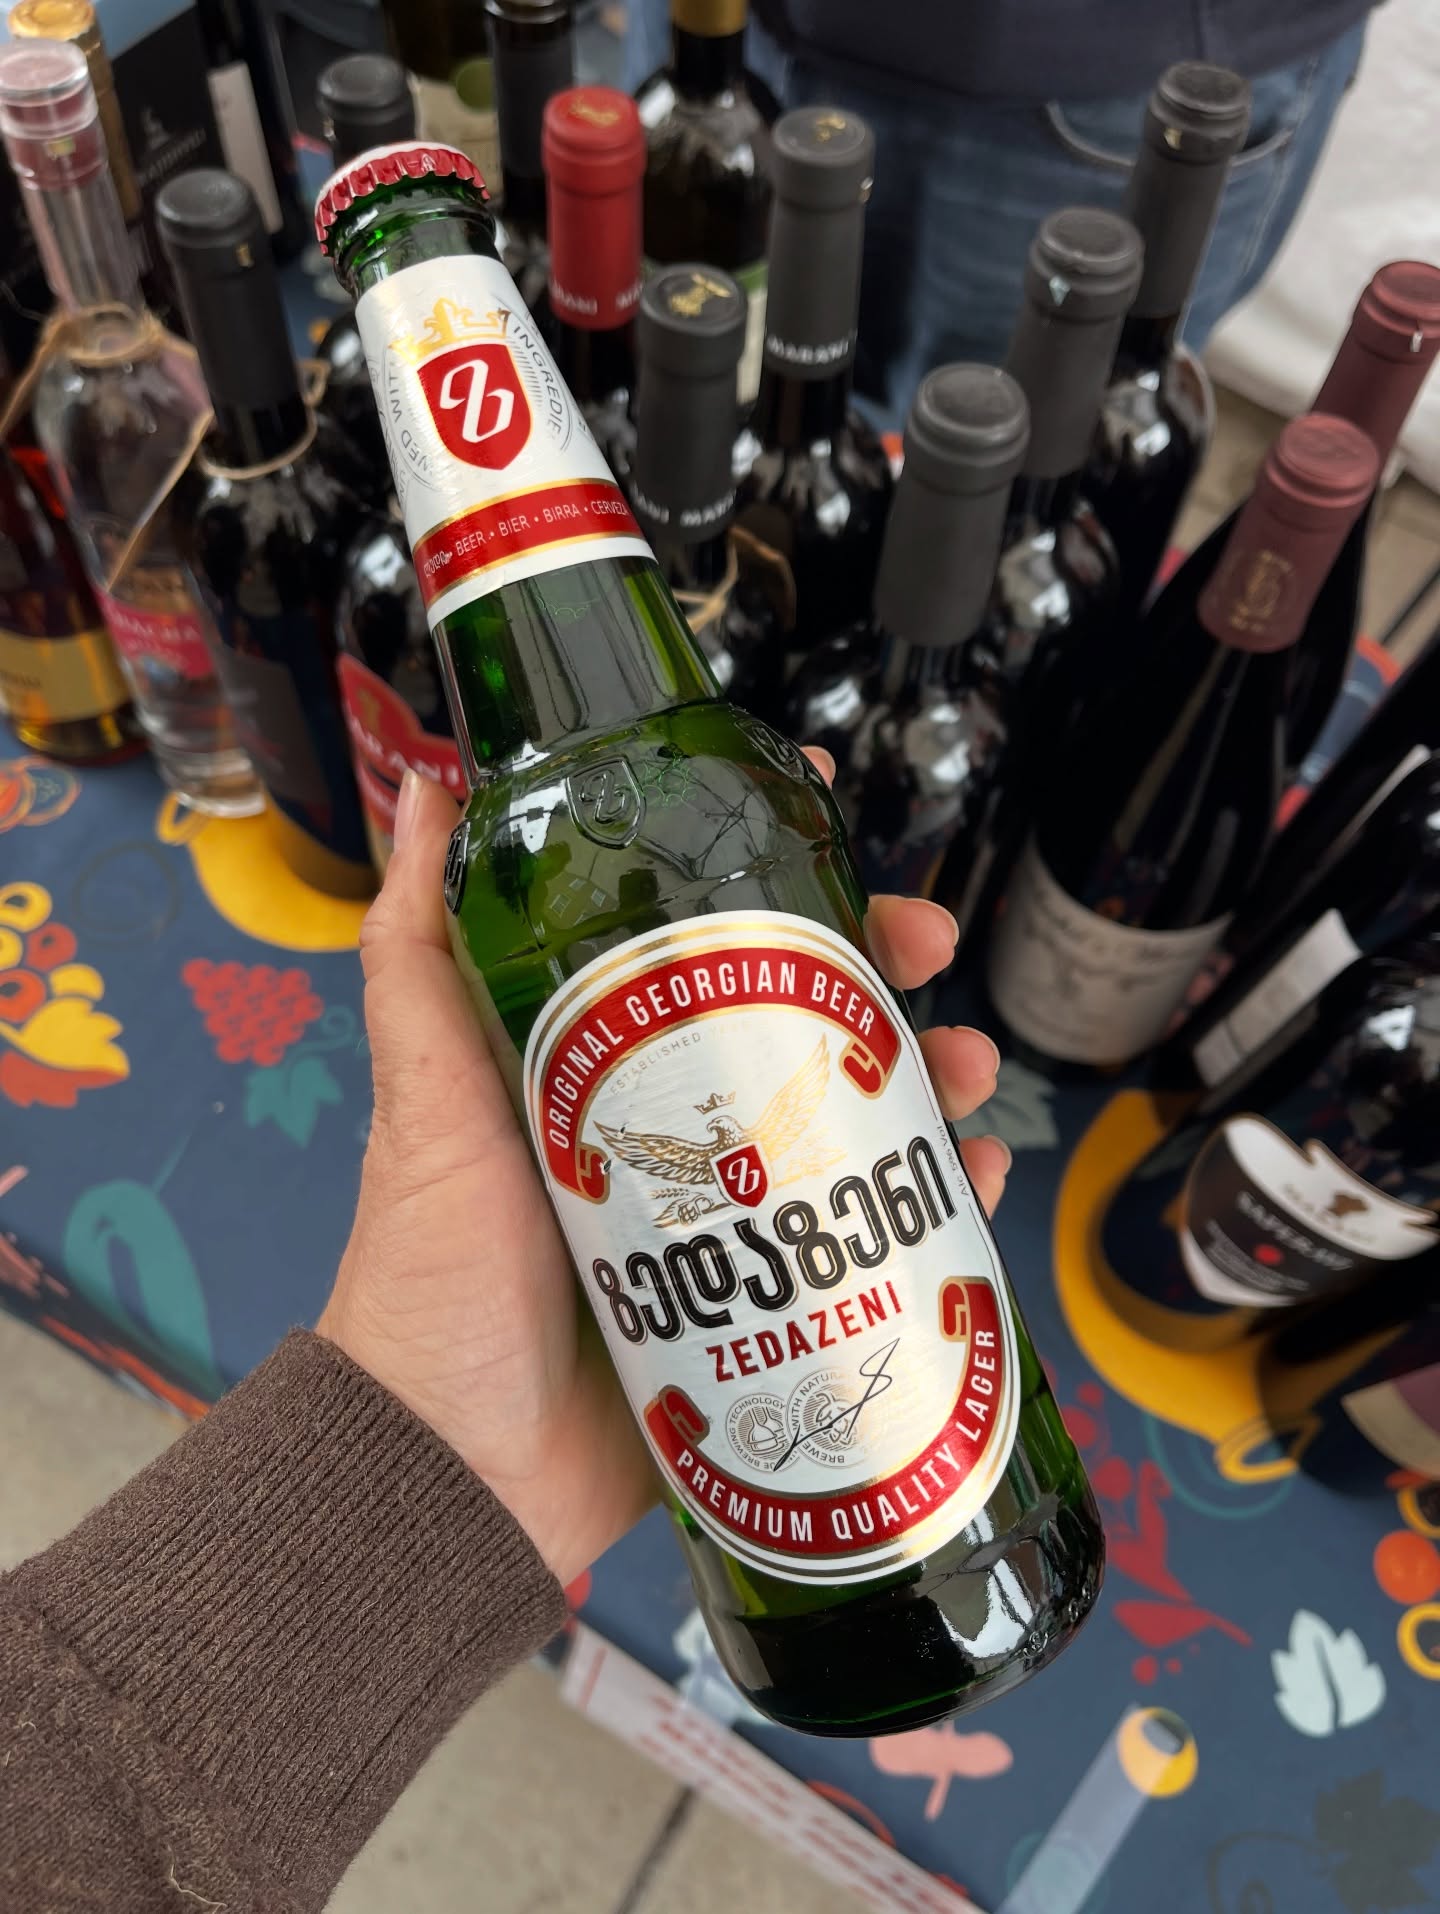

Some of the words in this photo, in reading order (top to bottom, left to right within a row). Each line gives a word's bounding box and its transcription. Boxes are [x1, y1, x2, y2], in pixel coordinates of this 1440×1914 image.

[455, 531, 485, 557] BEER
[498, 515, 531, 537] BIER
[542, 503, 581, 524] BIRRA
[548, 1018, 625, 1150] ORIGINAL
[625, 960, 797, 1027] GEORGIAN
[811, 971, 876, 1038] BEER
[609, 1030, 702, 1097] ESTABLISHED
[592, 1135, 958, 1345] ზედაზენი
[705, 1280, 903, 1383] ZEDAZENI
[676, 1449, 814, 1542] PREMIUM
[831, 1442, 963, 1540] QUALITY
[956, 1329, 996, 1443] LAGER
[729, 1396, 786, 1425] TECHNOLOGY
[801, 1440, 845, 1464] BREWE
